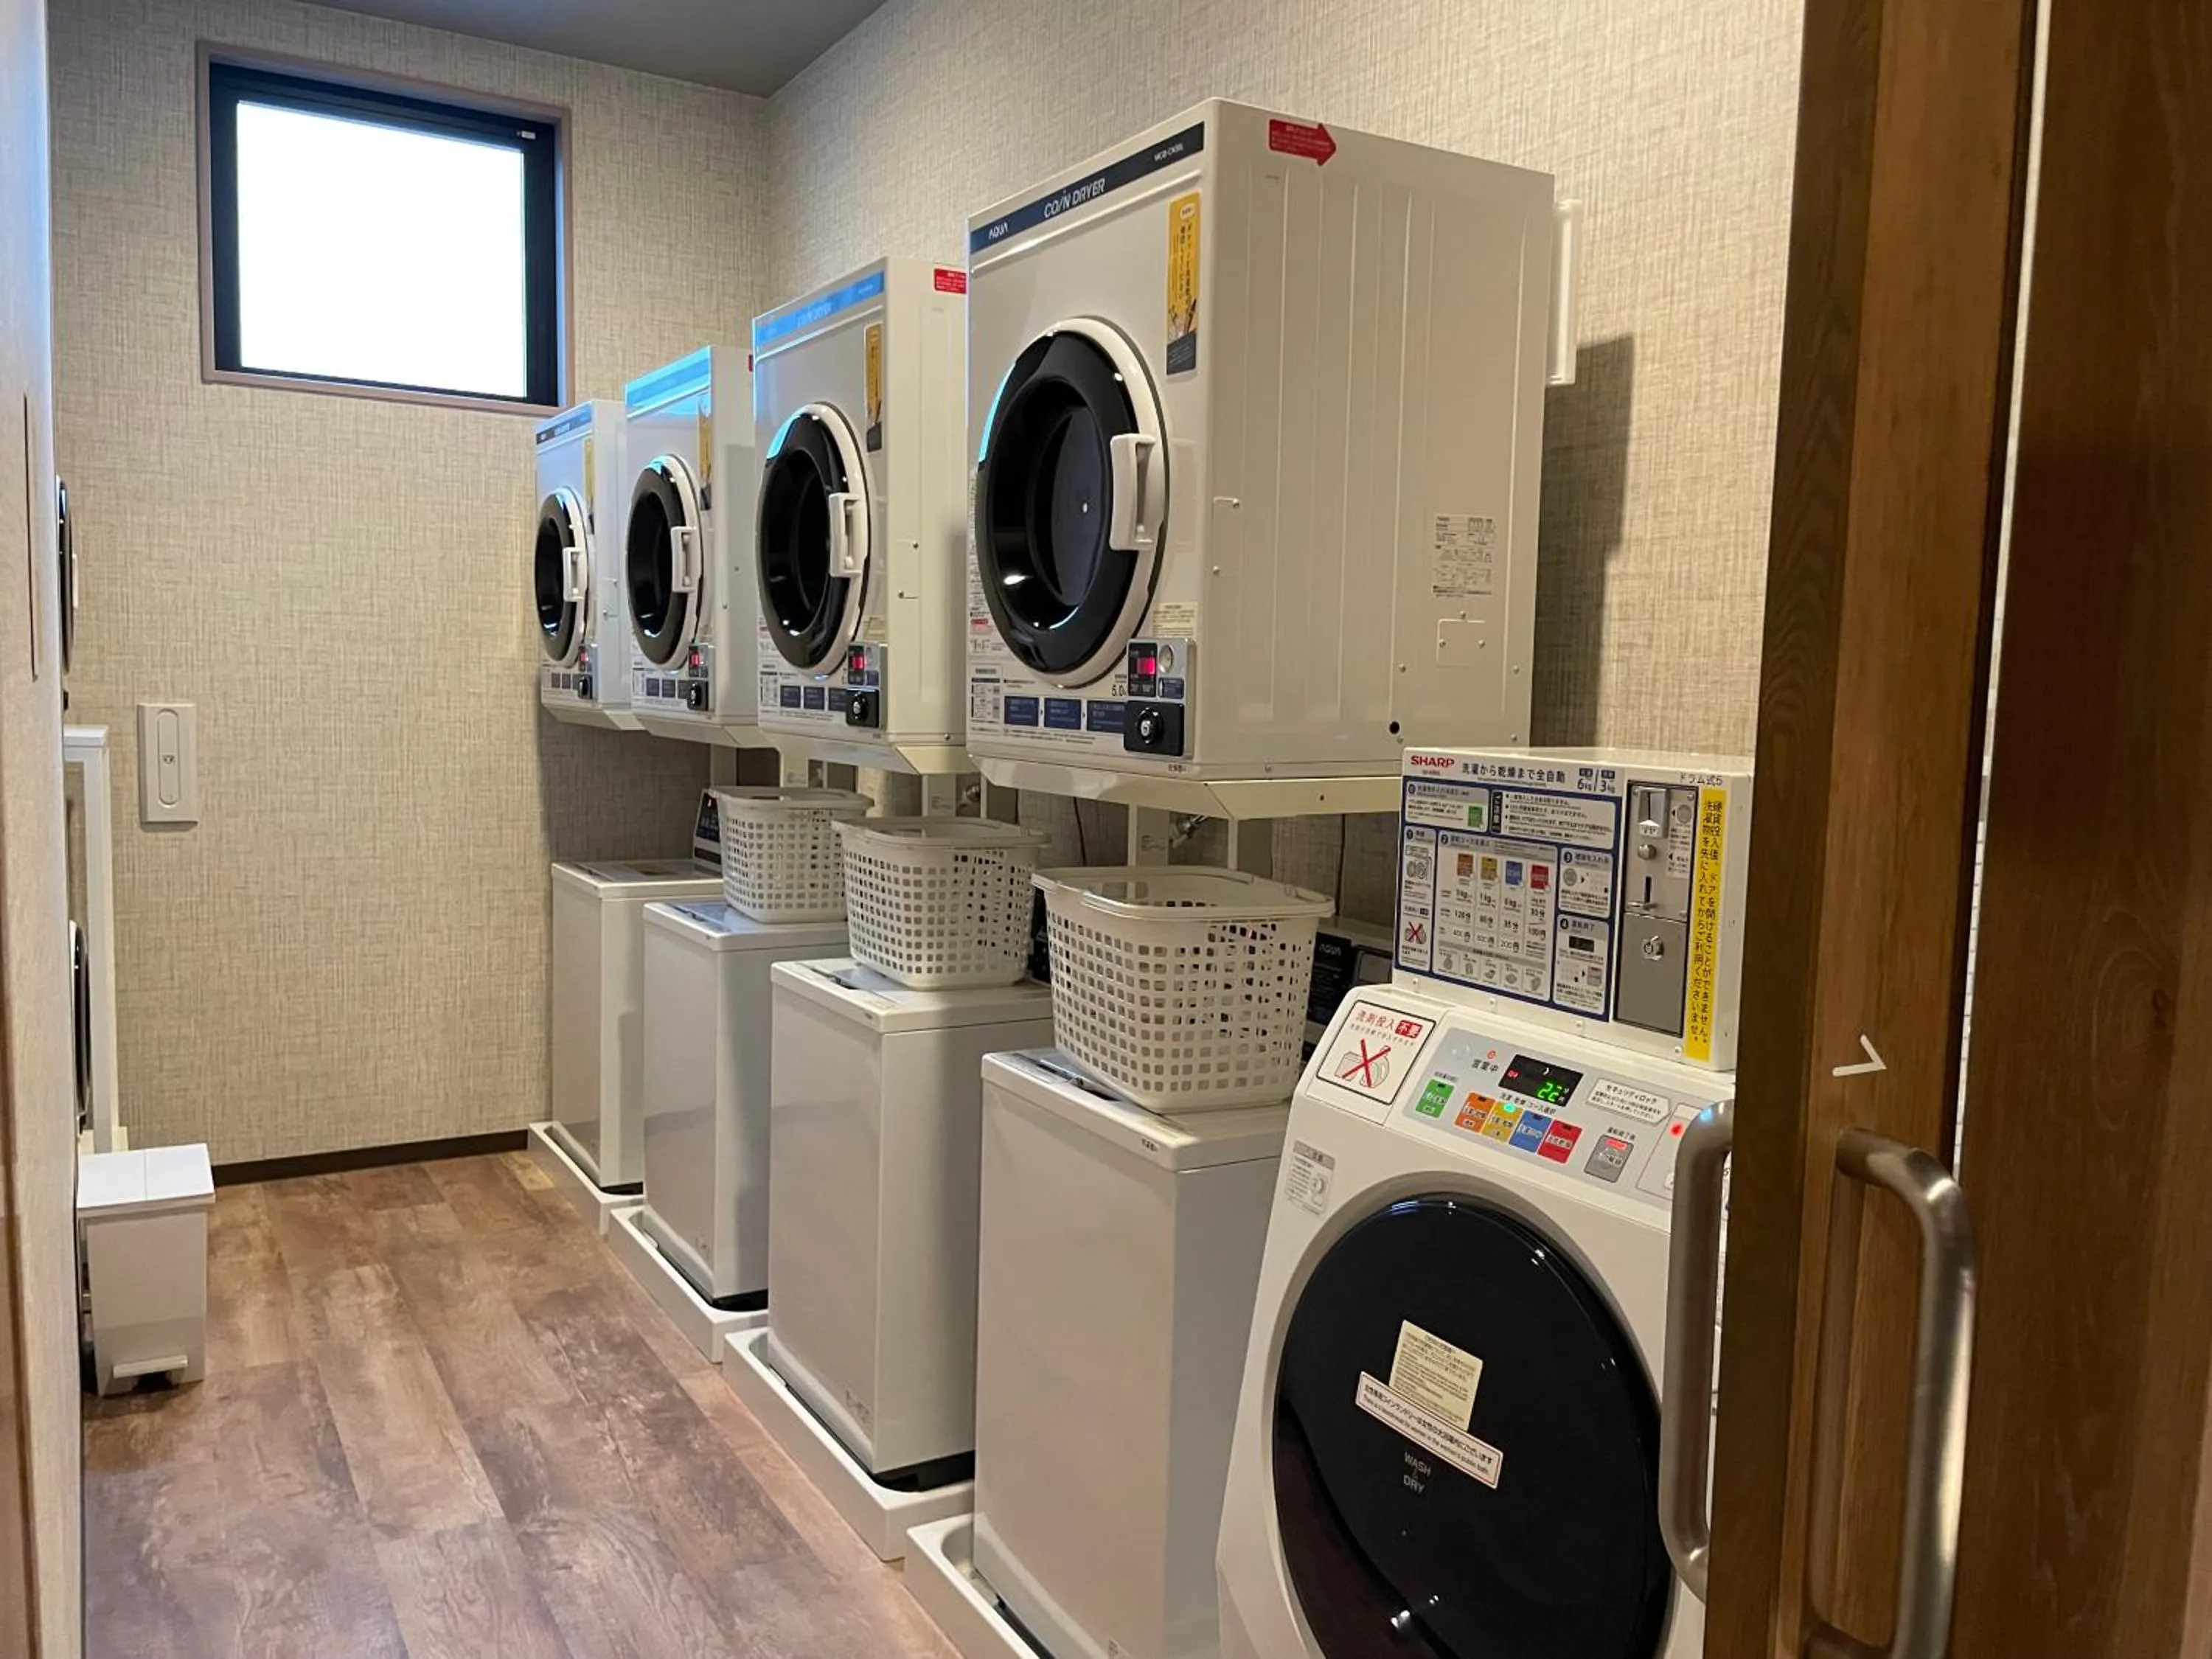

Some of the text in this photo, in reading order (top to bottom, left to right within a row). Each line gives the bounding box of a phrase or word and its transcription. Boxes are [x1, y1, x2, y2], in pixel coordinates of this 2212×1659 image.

[1072, 178, 1106, 205] DRYER
[988, 222, 1009, 240] AQUA
[1411, 755, 1455, 768] SHARP
[1405, 1451, 1431, 1476] WASH
[1403, 1475, 1426, 1494] DRY
